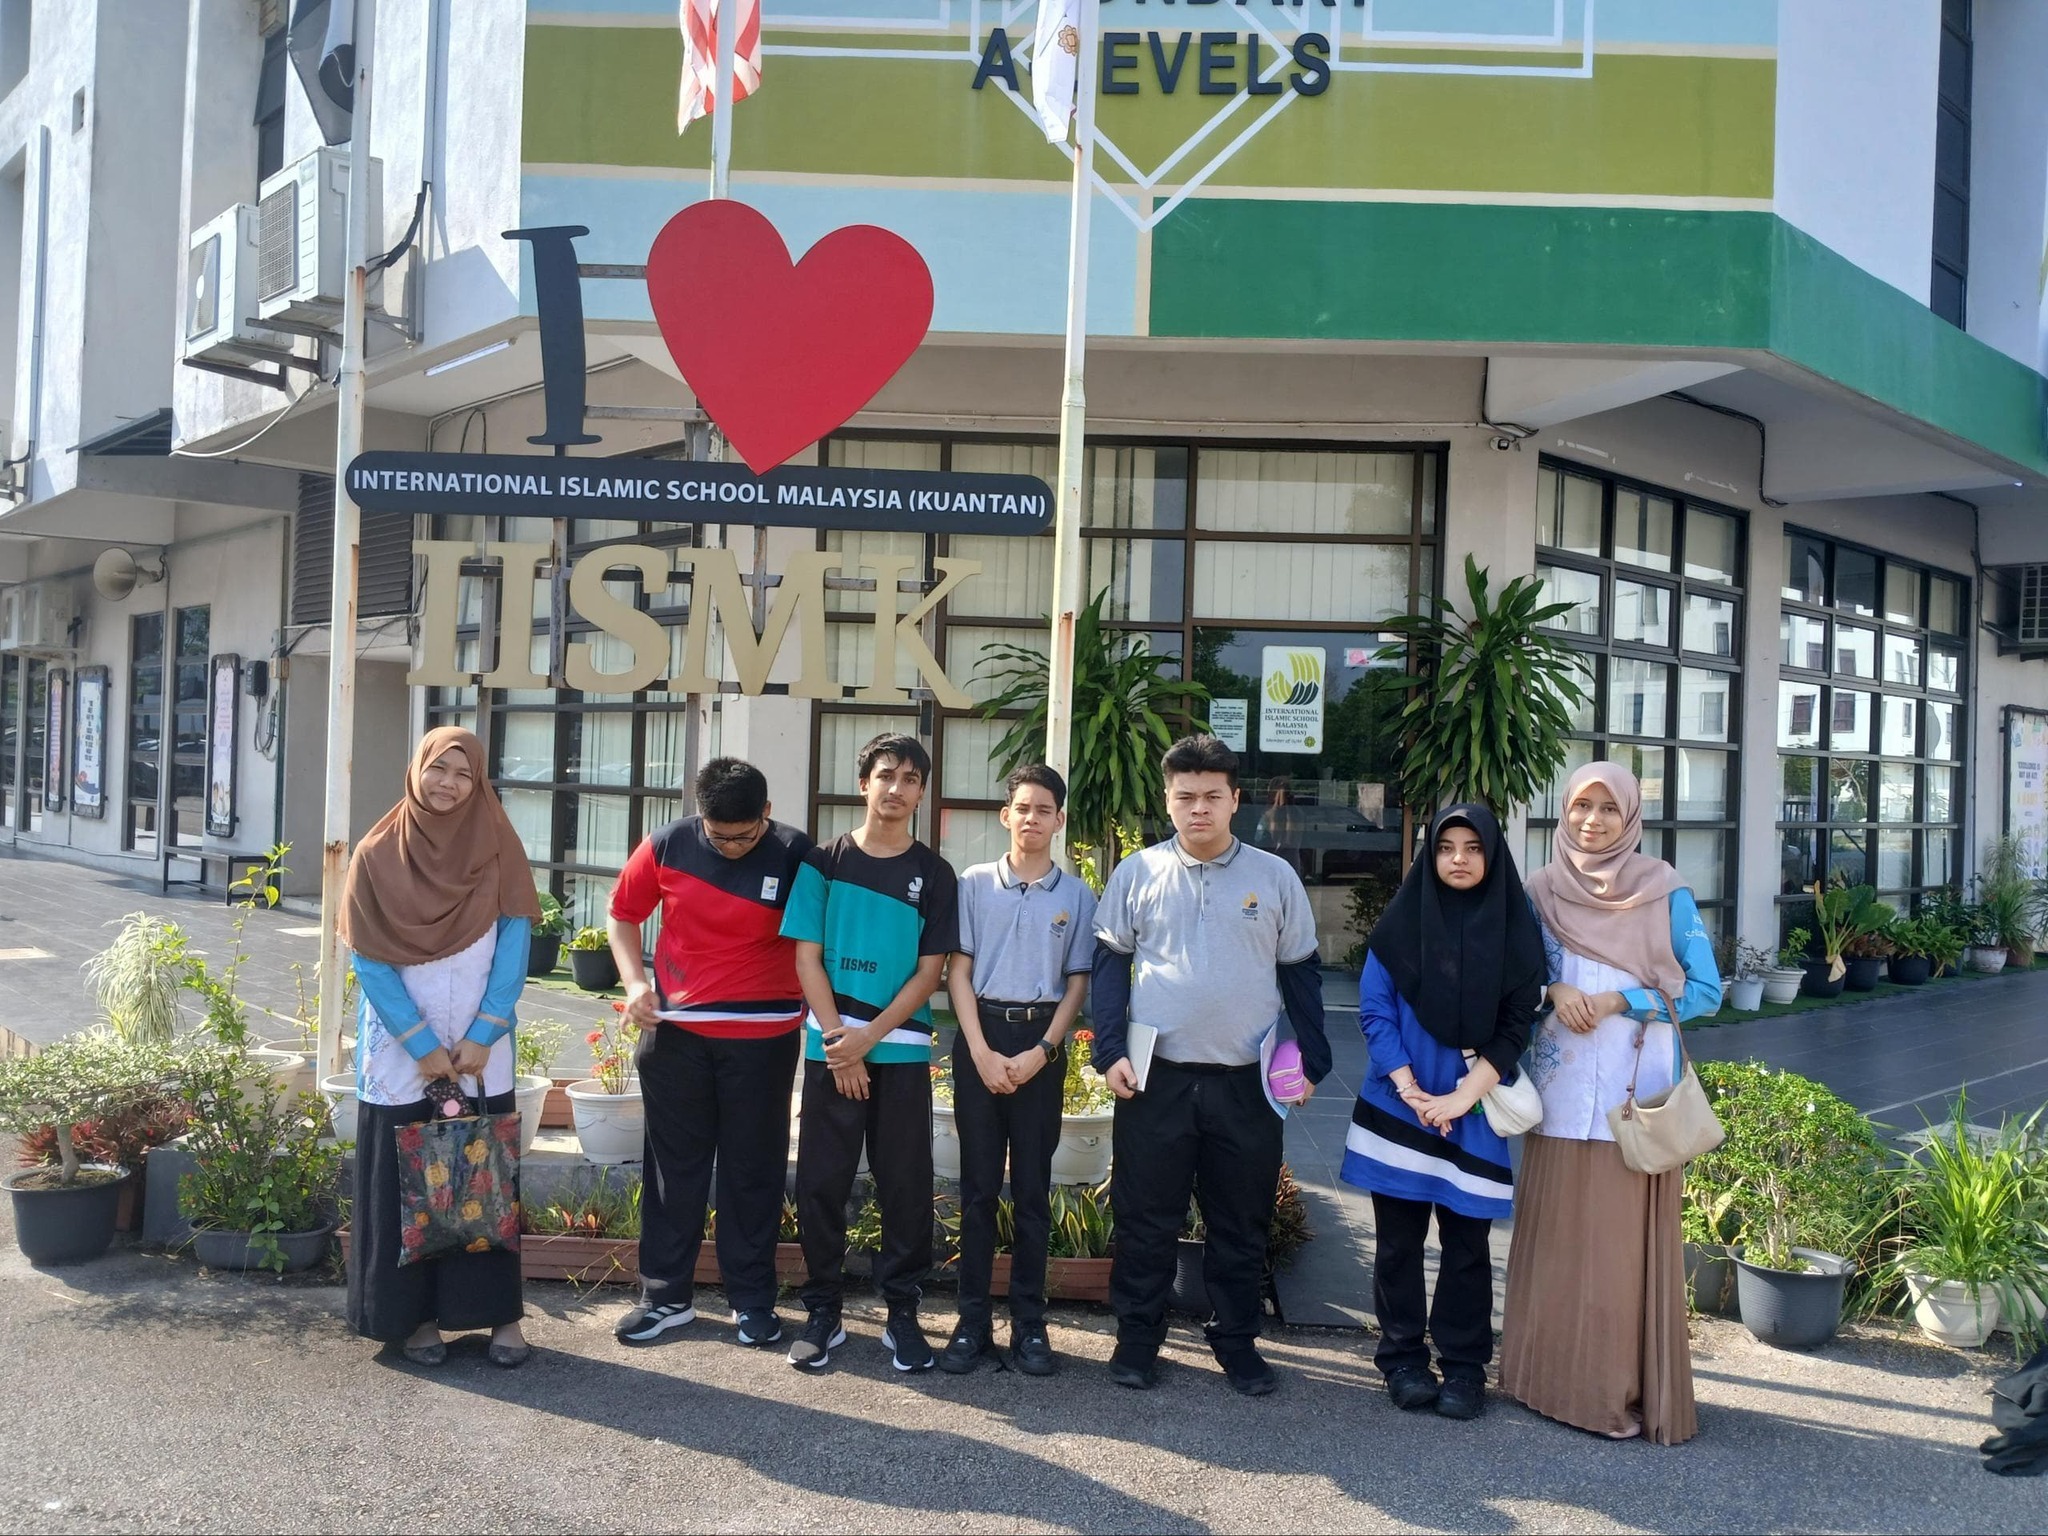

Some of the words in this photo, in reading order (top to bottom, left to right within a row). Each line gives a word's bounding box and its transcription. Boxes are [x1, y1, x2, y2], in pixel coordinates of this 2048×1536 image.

[972, 28, 1332, 97] AEVELS
[501, 225, 602, 445] I
[353, 469, 552, 496] INTERNATIONAL
[560, 476, 661, 500] ISLAMIC
[666, 480, 770, 504] SCHOOL
[777, 485, 903, 510] MALAYSIA
[909, 489, 1046, 518] (KUANTAN)
[406, 540, 982, 710] IISMK
[840, 957, 878, 974] IISMS
